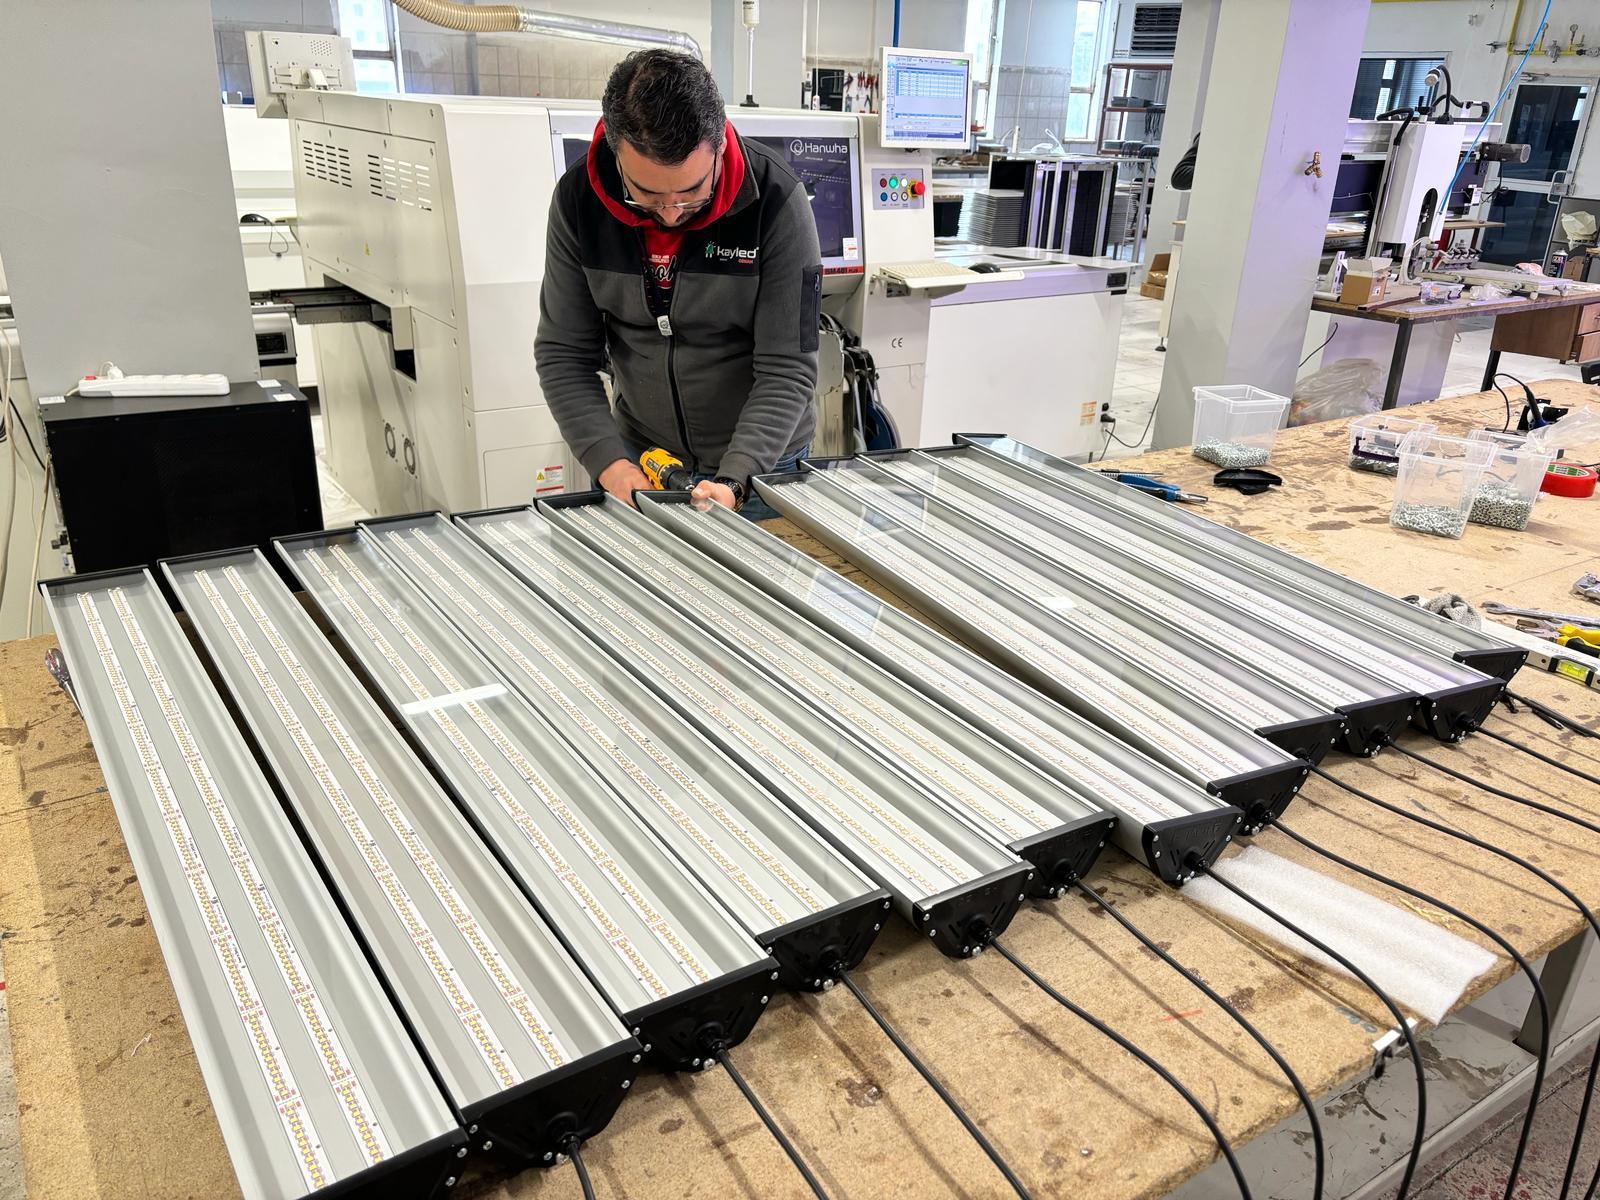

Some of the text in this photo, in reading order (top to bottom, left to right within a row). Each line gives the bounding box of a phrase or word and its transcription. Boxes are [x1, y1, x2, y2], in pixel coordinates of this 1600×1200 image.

[804, 142, 848, 154] Hanwha
[717, 246, 757, 259] kayled
[891, 337, 903, 348] CE
